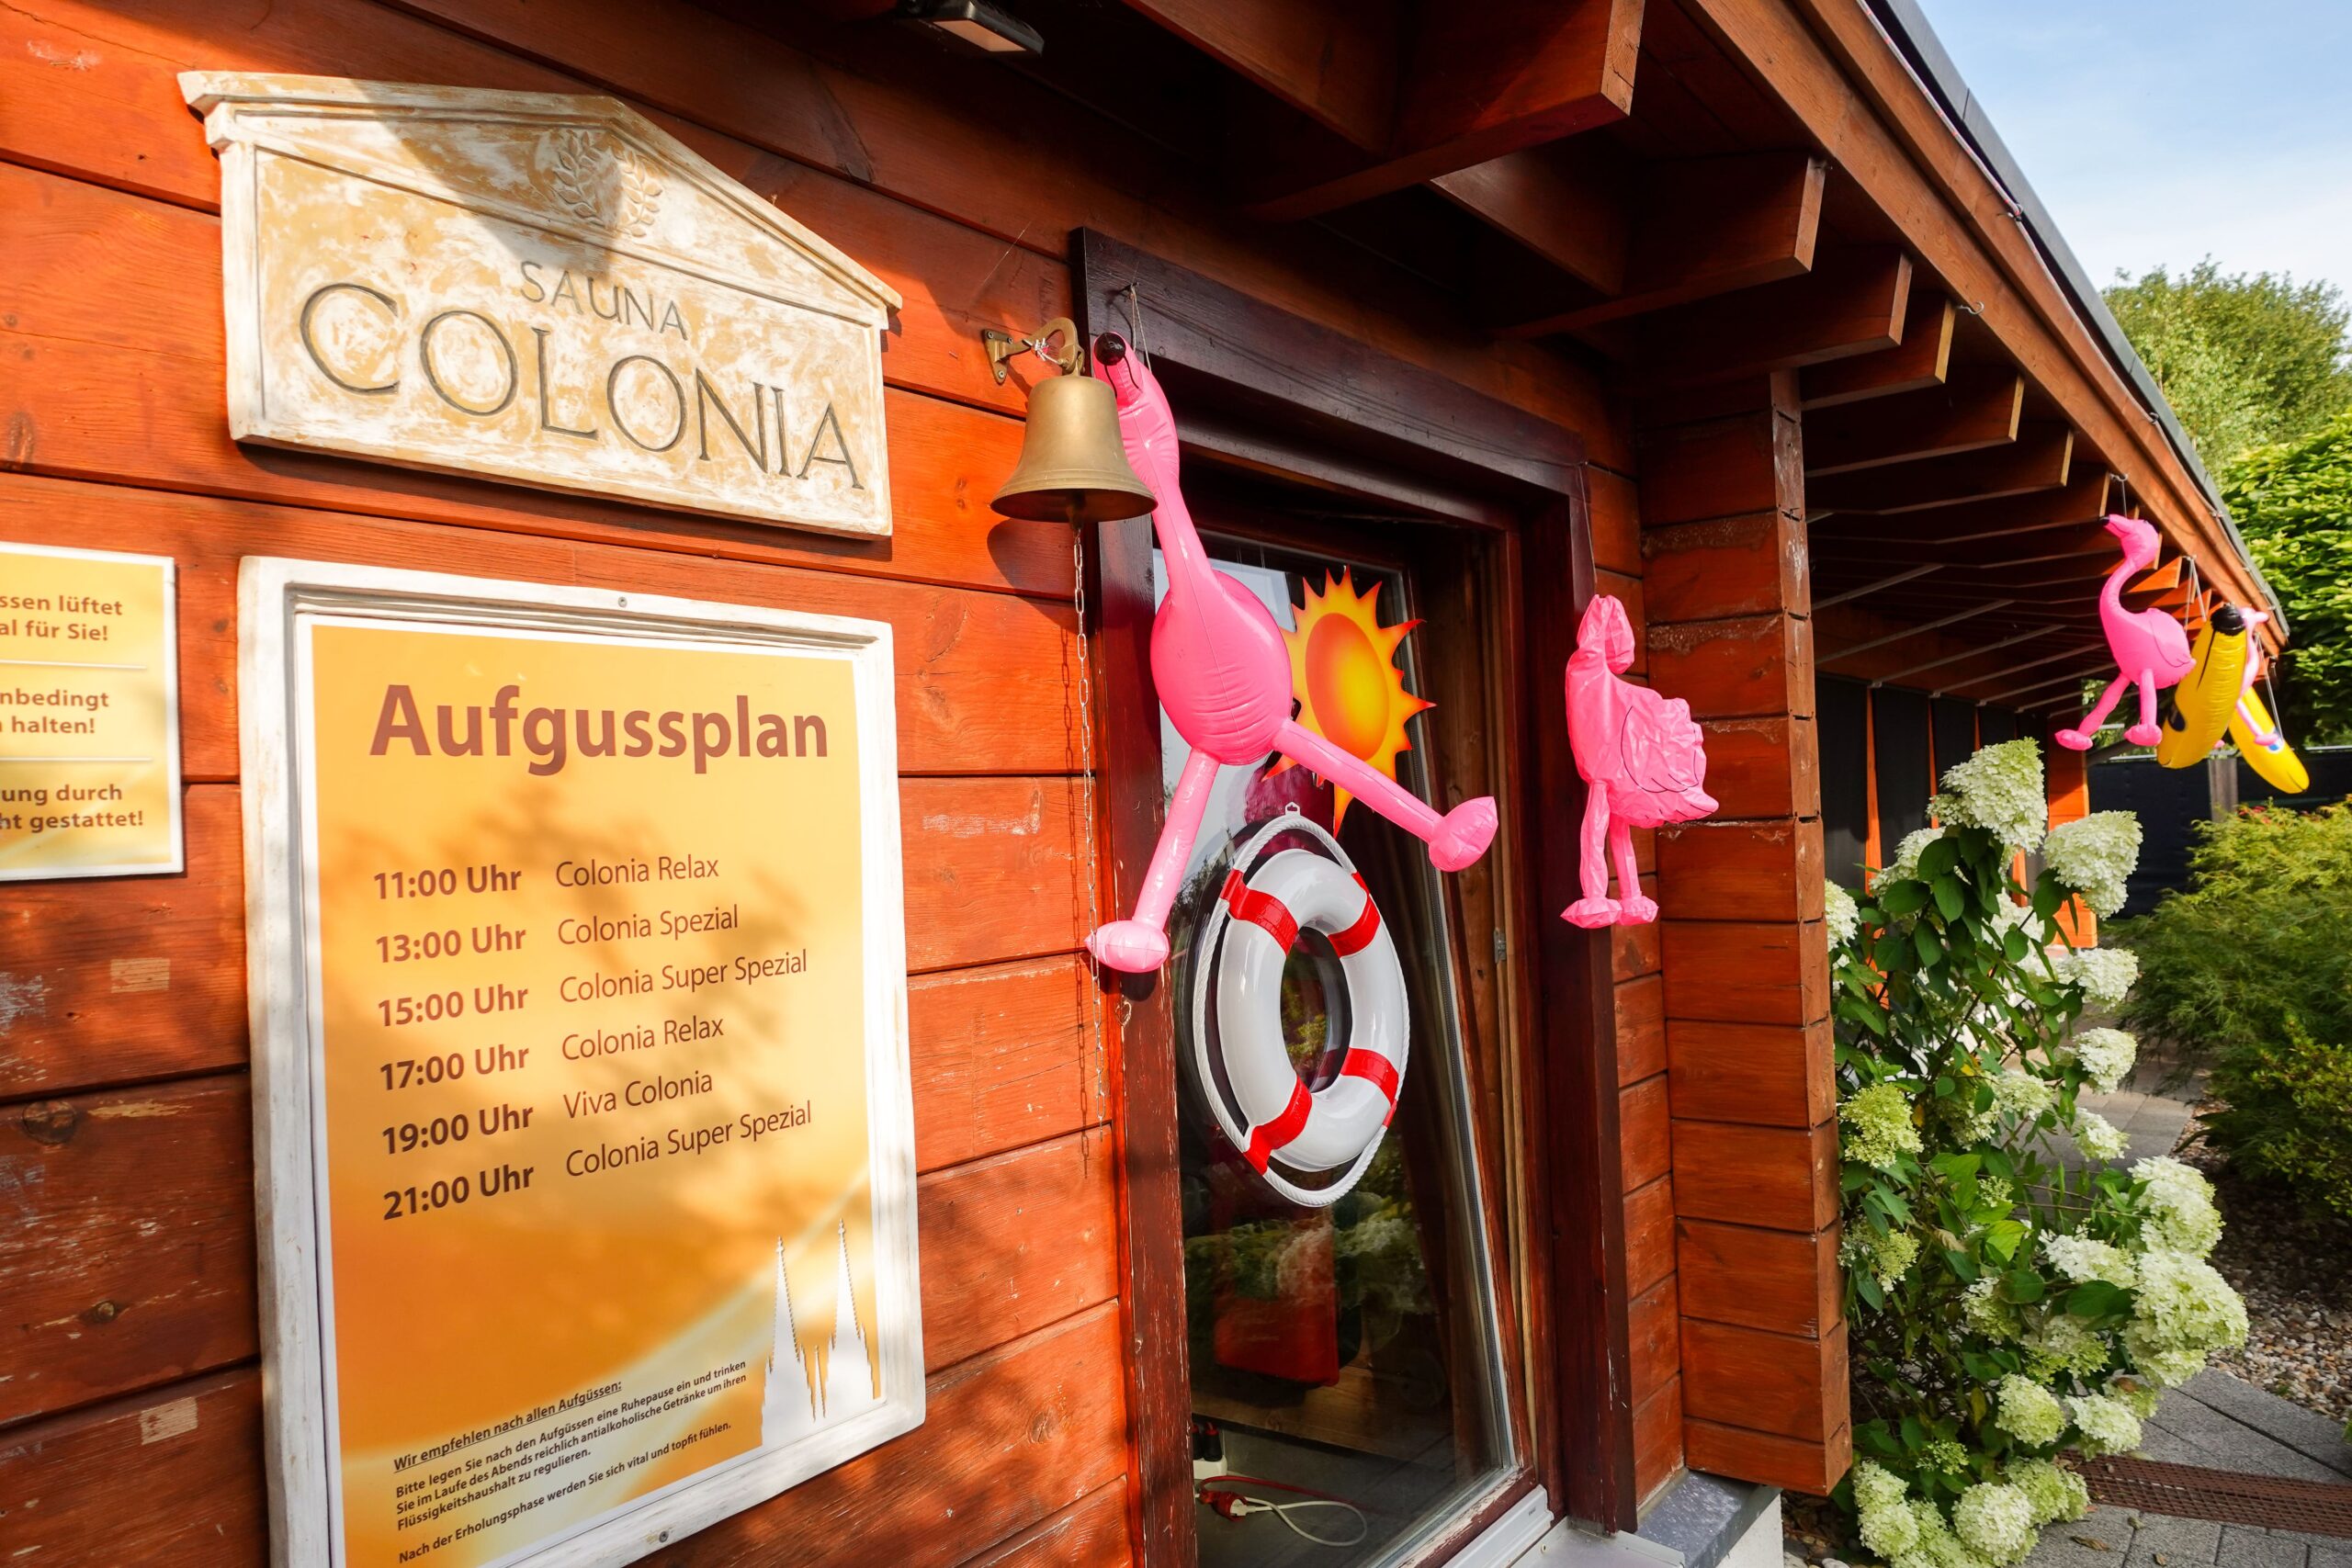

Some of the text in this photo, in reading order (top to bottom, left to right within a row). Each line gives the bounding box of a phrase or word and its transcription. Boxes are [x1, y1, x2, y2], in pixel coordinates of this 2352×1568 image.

[520, 260, 689, 341] SAUNA
[299, 283, 865, 491] COLONIA
[26, 619, 60, 638] für
[67, 623, 108, 642] Sie!
[59, 594, 123, 616] lüftet
[11, 715, 96, 734] halten!
[369, 683, 828, 776] Aufgussplan
[29, 809, 143, 833] gestattet!
[56, 784, 123, 801] durch
[373, 853, 719, 900] 11:00 Uhr Colonia Relax
[375, 904, 739, 965] 13:00 Uhr Colonia Spezial
[377, 949, 808, 1027] 15:00 Uhr Colonia Super Spezial
[379, 1015, 724, 1091] 17:00 Uhr Colonia Relax
[382, 1070, 713, 1156] 19:00 Uhr Viva Colonia
[383, 1100, 812, 1221] 21:00 Uhr Colonia Super Spezial
[393, 1381, 622, 1472] Wir empfehlen nach allen Aufgüssen:
[396, 1360, 746, 1498] Bitte legen Sie nach den Aufgüssen eine Ruhepause ein und trinken
[396, 1374, 747, 1515] Sie im Laufe des Abends reichlich antialkoholische Getränke um ihren
[398, 1449, 592, 1531] Flüssigkeitshaushalt zu regulieren.
[399, 1421, 732, 1564] Nach der Erholungsphase werden Sie sich vital und topfit fühlen.
